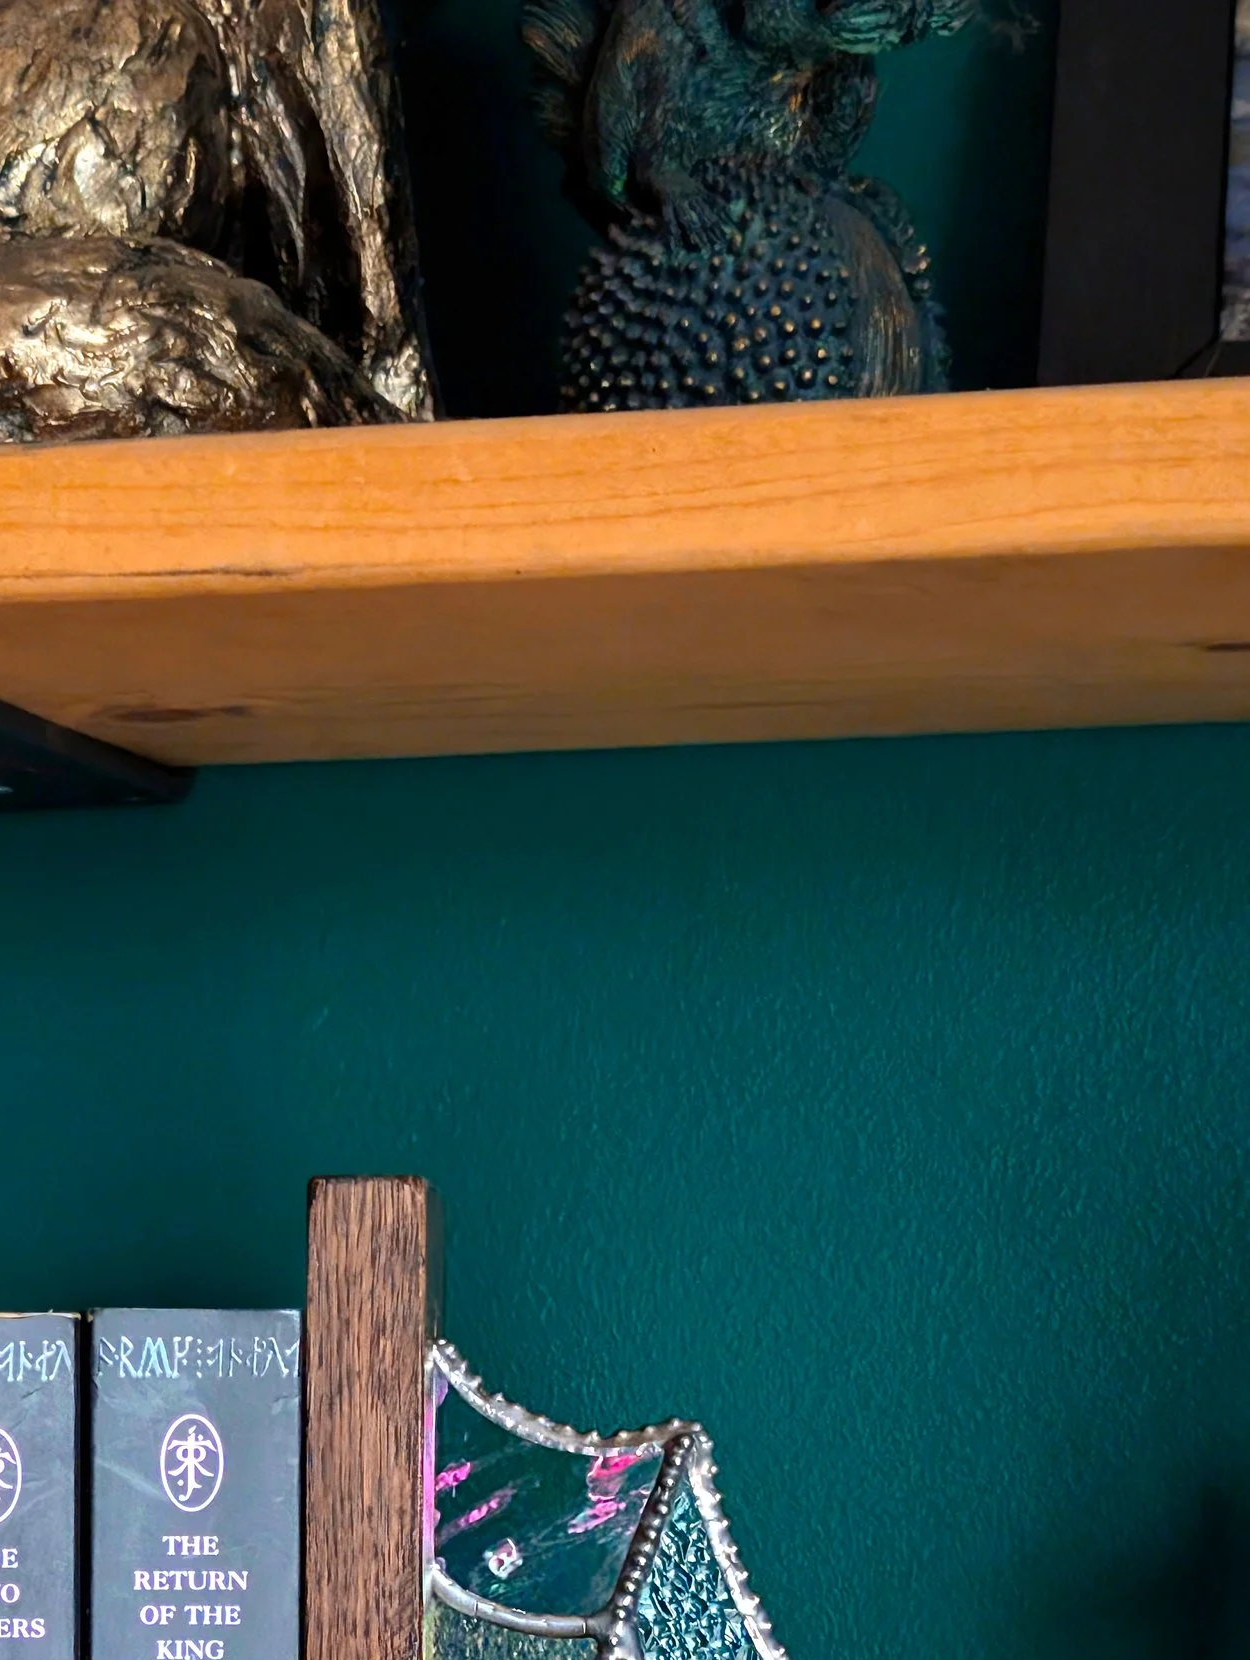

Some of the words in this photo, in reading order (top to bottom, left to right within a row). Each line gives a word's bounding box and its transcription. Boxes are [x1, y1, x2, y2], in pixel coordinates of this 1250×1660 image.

[161, 1535, 220, 1556] THE
[133, 1570, 249, 1592] RETURN
[139, 1604, 179, 1627] OF
[186, 1604, 241, 1626] THE
[156, 1639, 225, 1660] KING
